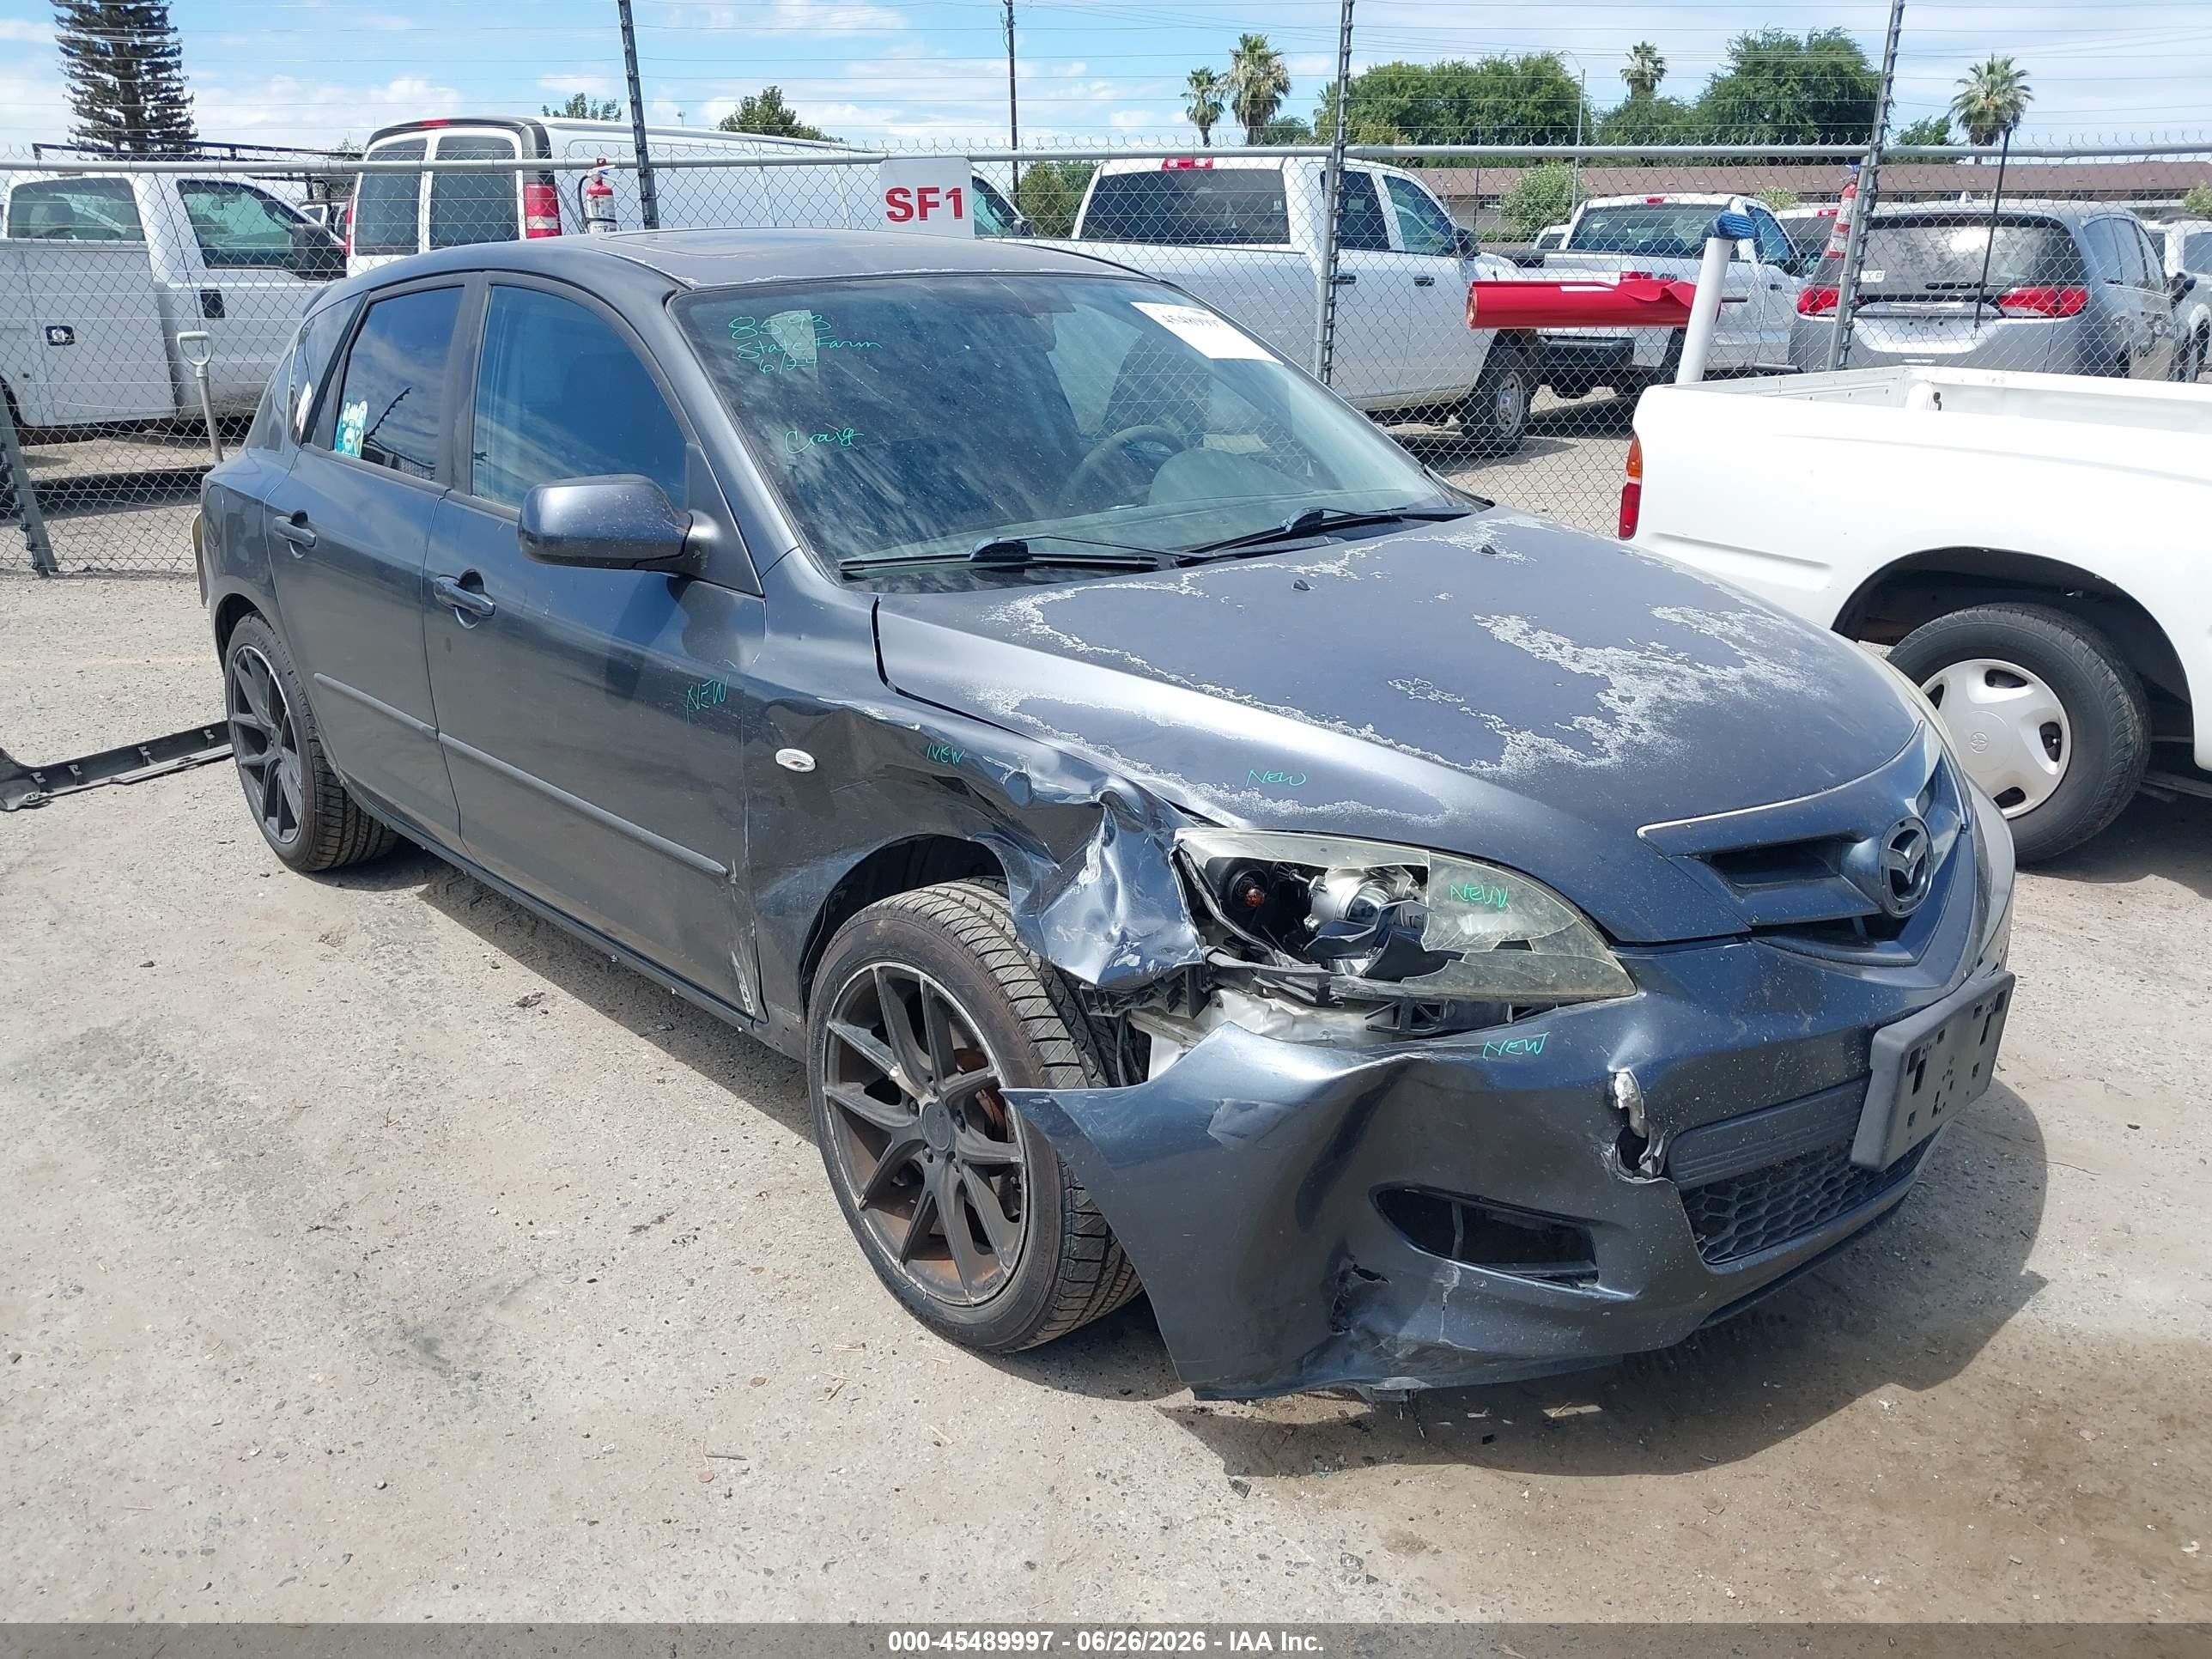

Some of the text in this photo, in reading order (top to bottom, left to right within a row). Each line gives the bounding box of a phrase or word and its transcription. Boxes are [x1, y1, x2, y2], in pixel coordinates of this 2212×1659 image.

[885, 186, 963, 223] SF1
[728, 314, 832, 339] 8593
[737, 335, 883, 360] State Farm
[758, 351, 817, 375] 6/24
[686, 673, 730, 723] NEW
[927, 741, 966, 765] NEW
[1482, 1031, 1552, 1061] NEW
